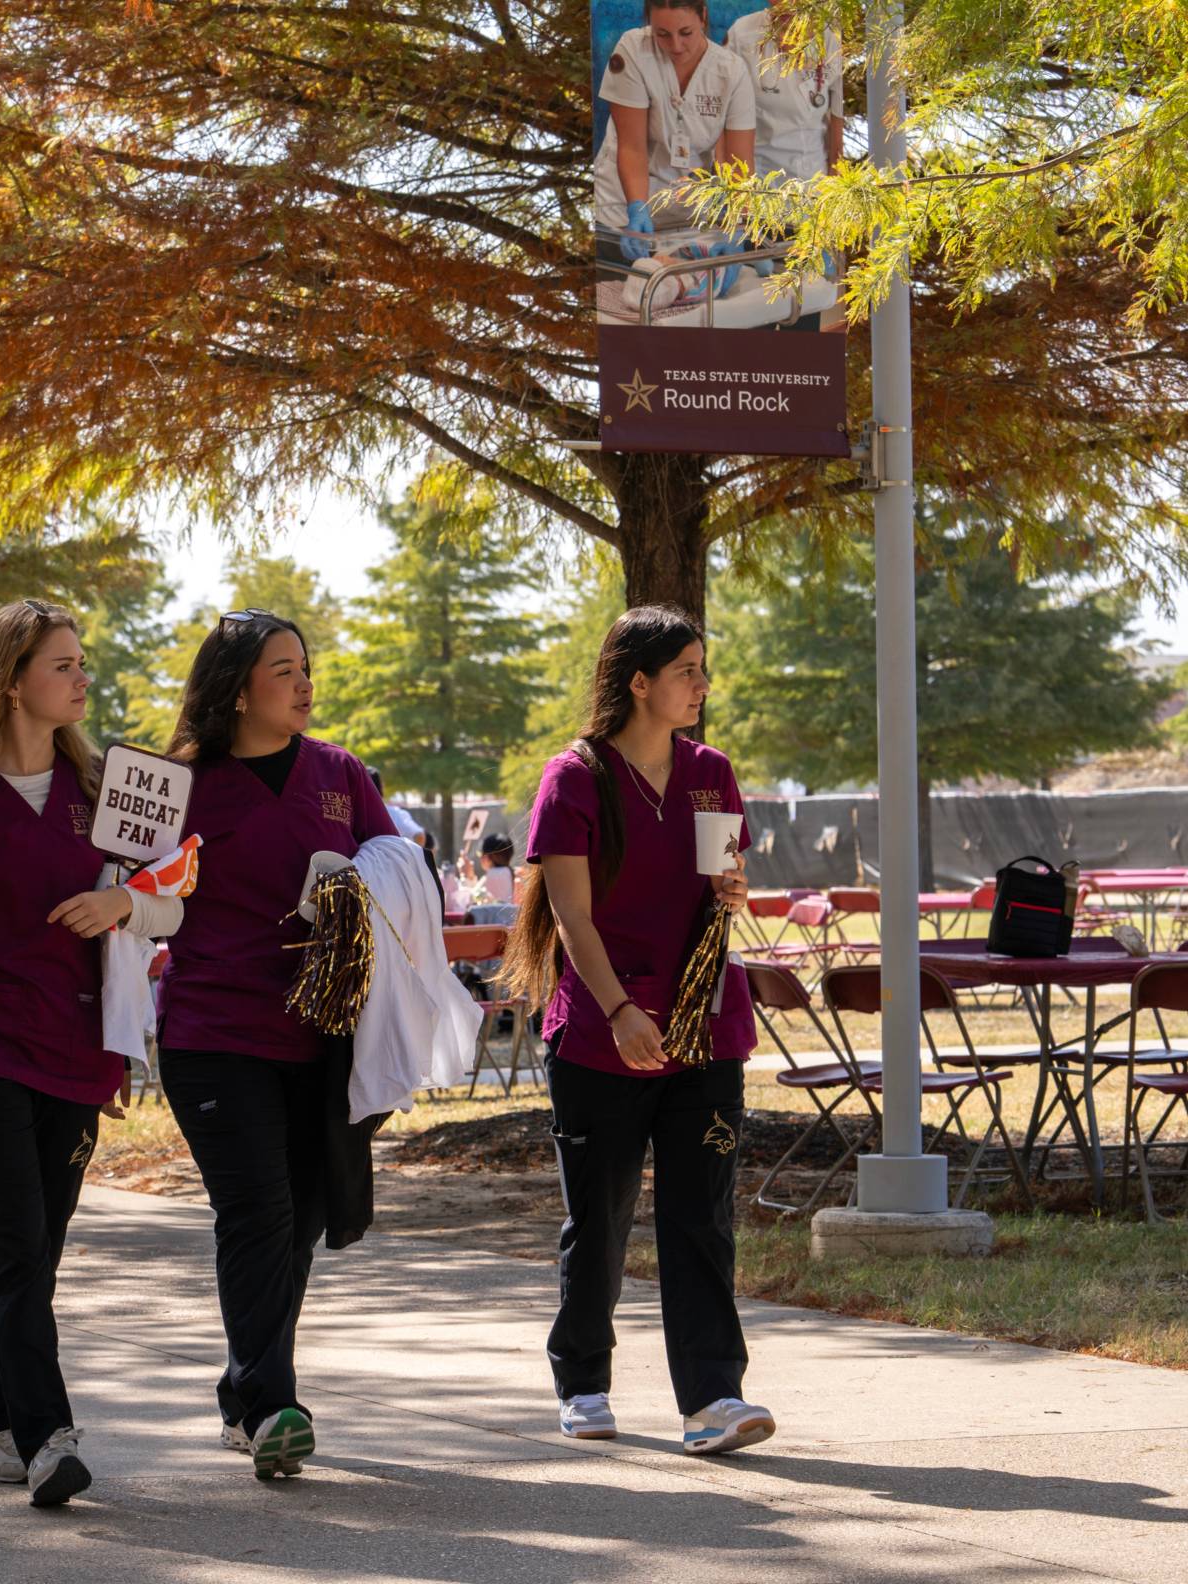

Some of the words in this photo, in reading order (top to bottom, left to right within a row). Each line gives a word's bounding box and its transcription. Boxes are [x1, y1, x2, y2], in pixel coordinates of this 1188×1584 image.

[695, 95, 722, 103] TEXAS
[696, 105, 722, 113] STATE
[664, 370, 706, 381] TEXAS
[709, 372, 749, 383] STATE
[752, 373, 830, 386] UNIVERSITY
[664, 388, 731, 409] Round
[738, 390, 790, 413] Rock
[125, 766, 154, 792] I'M
[157, 777, 170, 797] A
[317, 791, 352, 805] TEXAS
[687, 789, 721, 800] TEXAS
[106, 788, 180, 827] BOBCAT
[693, 804, 722, 812] STATE
[116, 820, 157, 848] FAN
